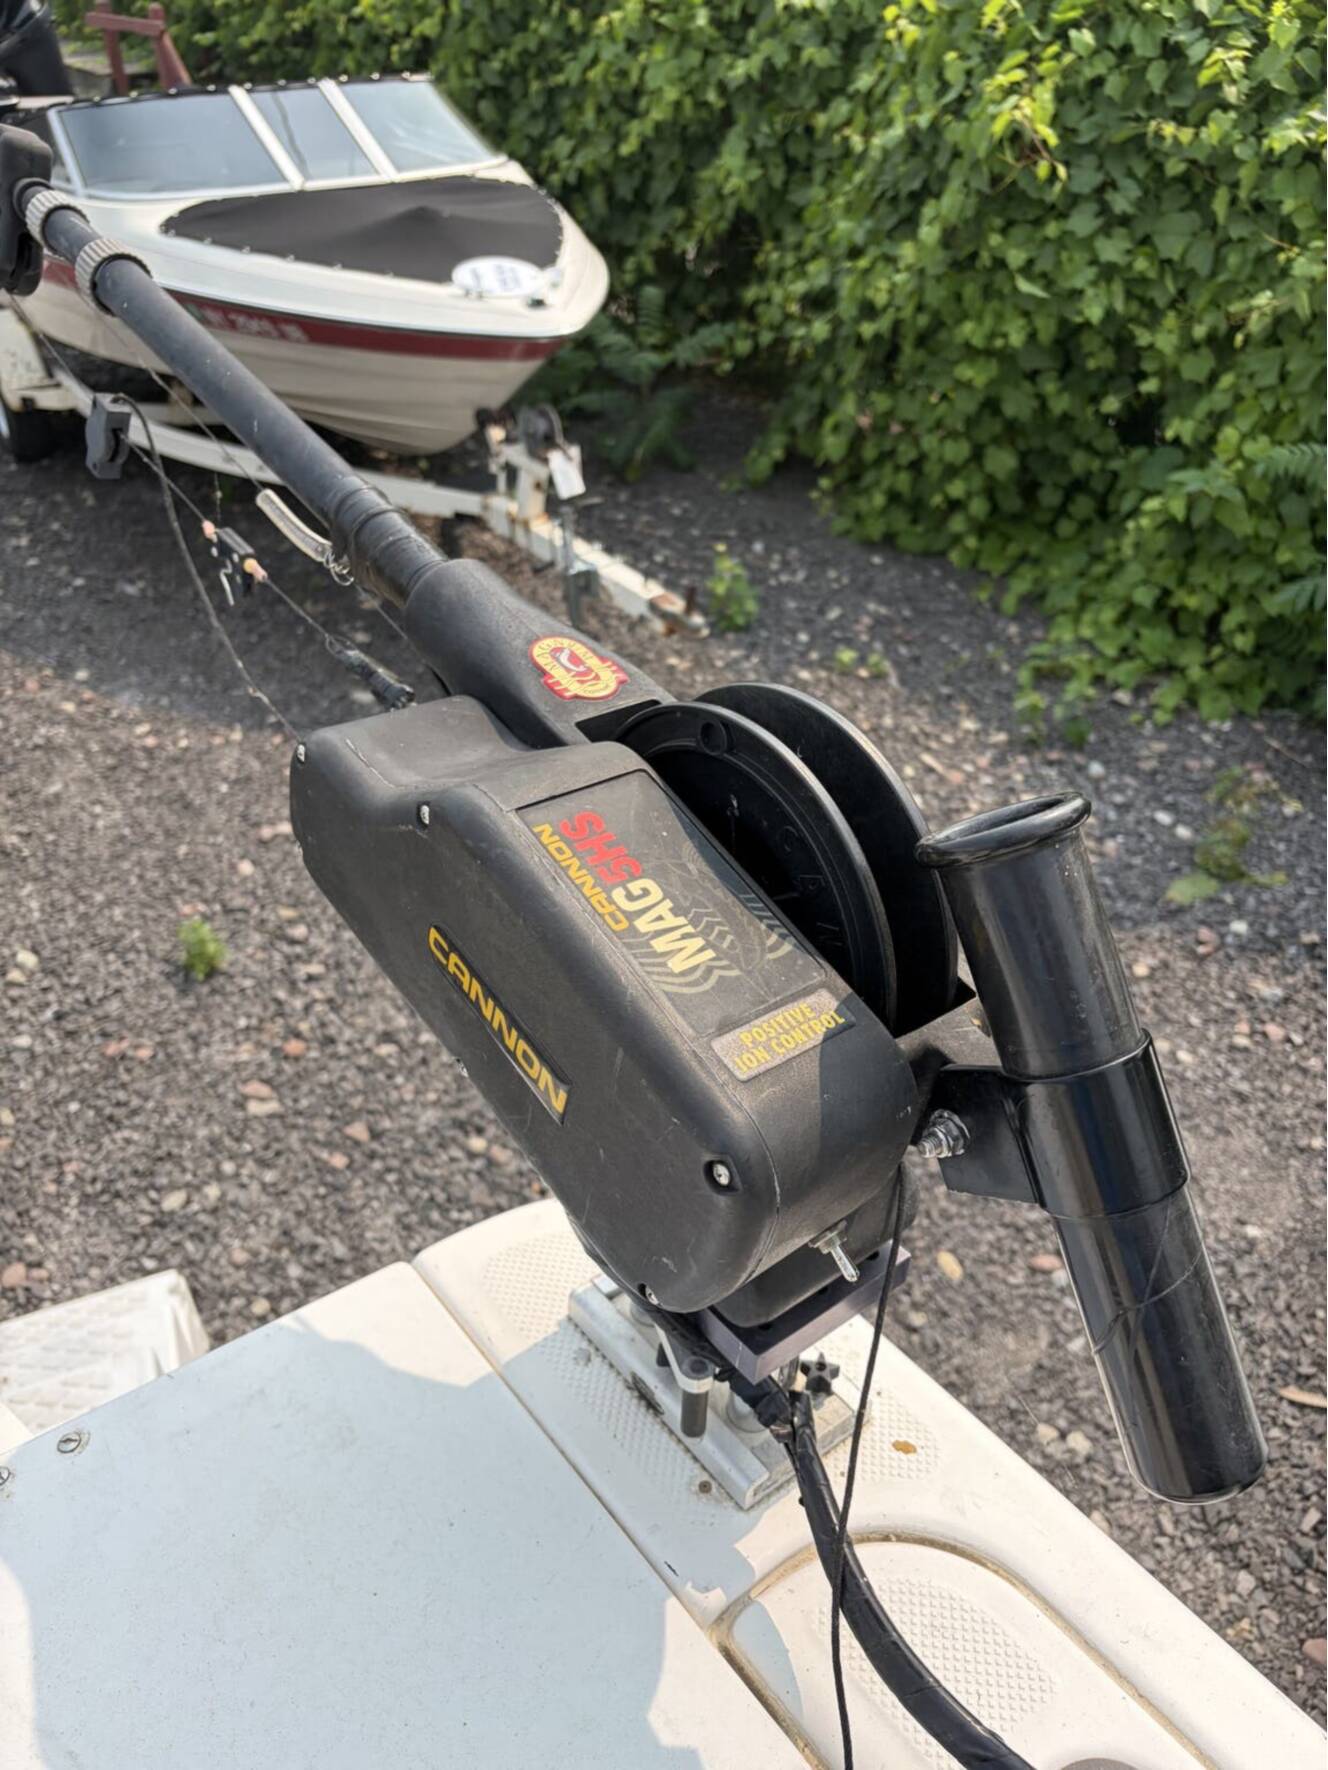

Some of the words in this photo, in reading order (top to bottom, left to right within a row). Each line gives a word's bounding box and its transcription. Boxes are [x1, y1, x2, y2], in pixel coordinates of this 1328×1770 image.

[533, 823, 629, 932] CANNON
[428, 927, 568, 1115] CANNON
[734, 1048, 770, 1072] ION
[770, 1011, 845, 1056] CONTROL
[740, 1003, 815, 1047] POSITIVE
